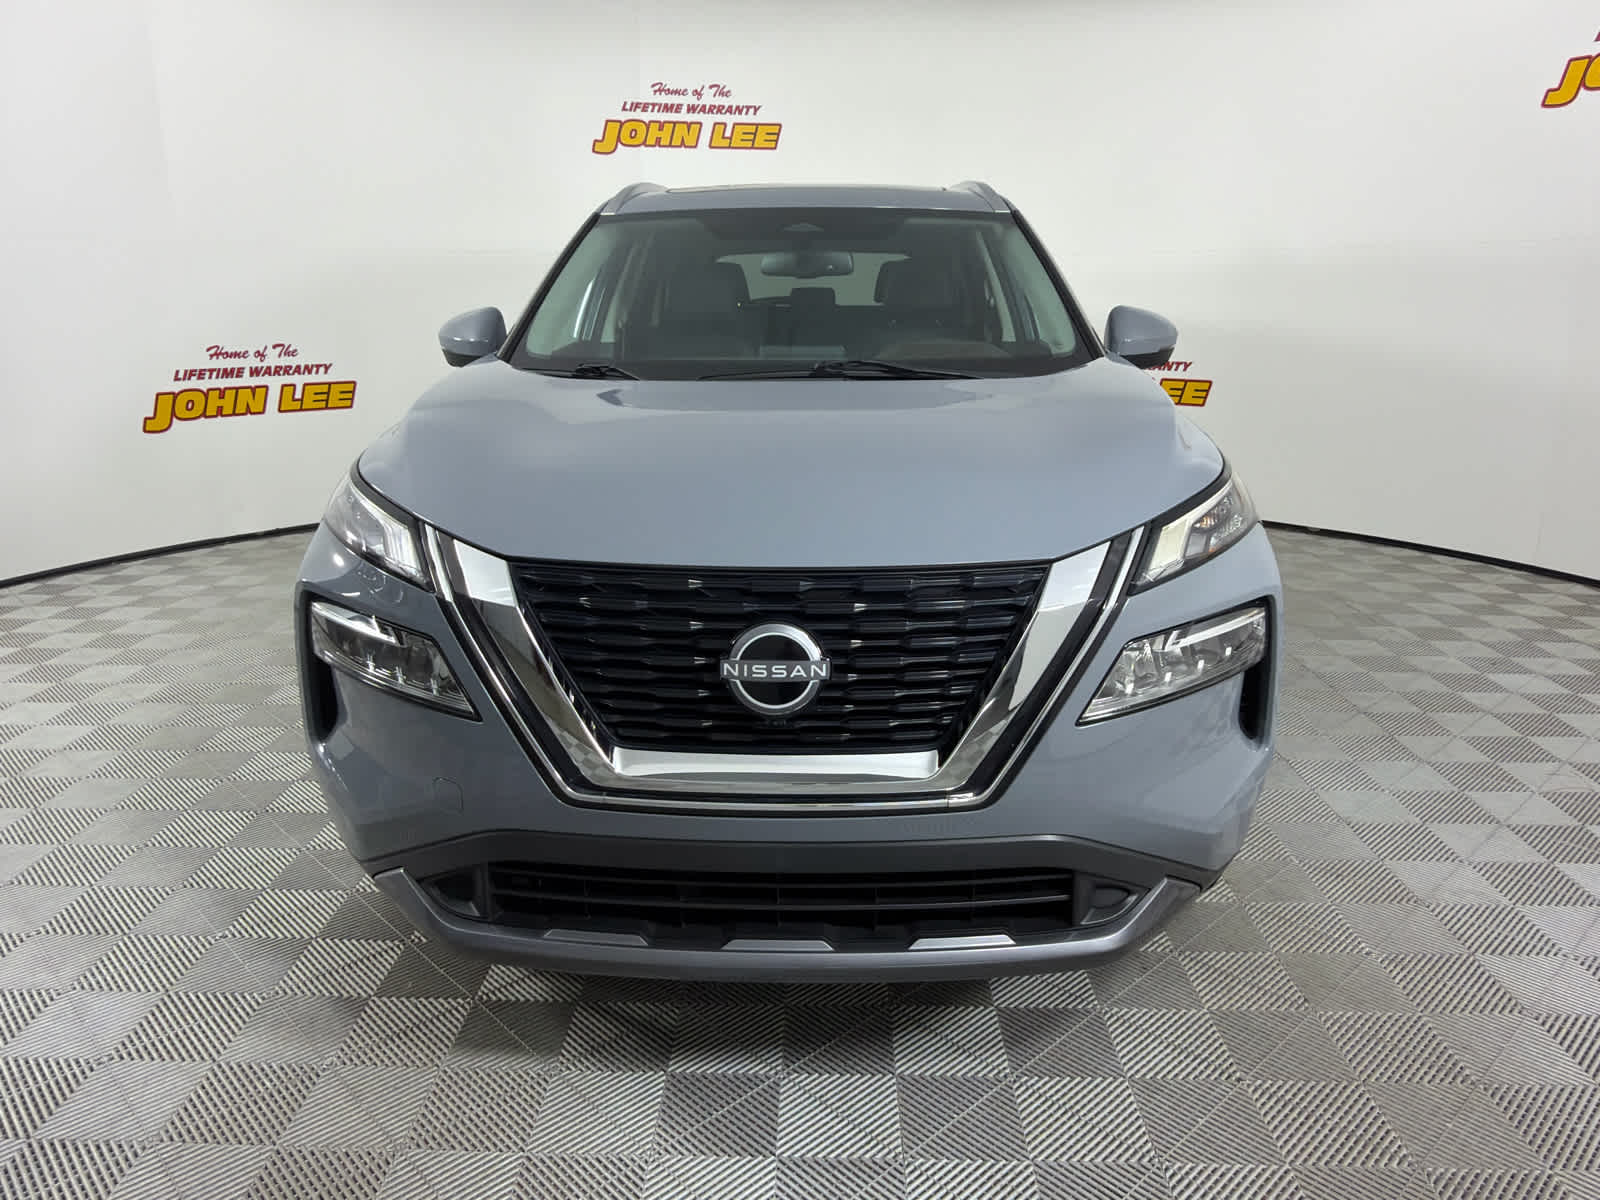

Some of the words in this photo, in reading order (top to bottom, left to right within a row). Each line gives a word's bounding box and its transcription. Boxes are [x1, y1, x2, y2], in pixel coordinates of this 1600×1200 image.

[651, 82, 688, 97] Home
[692, 84, 705, 100] of
[709, 84, 732, 98] The
[621, 101, 683, 114] LIFETIME
[686, 103, 761, 116] WARRANTY
[592, 119, 702, 154] JOHN
[709, 122, 782, 150] LEE
[206, 345, 249, 360] Home
[254, 346, 267, 362] of
[272, 343, 298, 358] The
[173, 367, 245, 382] LIFETIME
[249, 363, 332, 378] WARRANTY
[143, 385, 269, 433] JOHN
[278, 380, 356, 413] LEE
[723, 663, 826, 678] NISSAN
